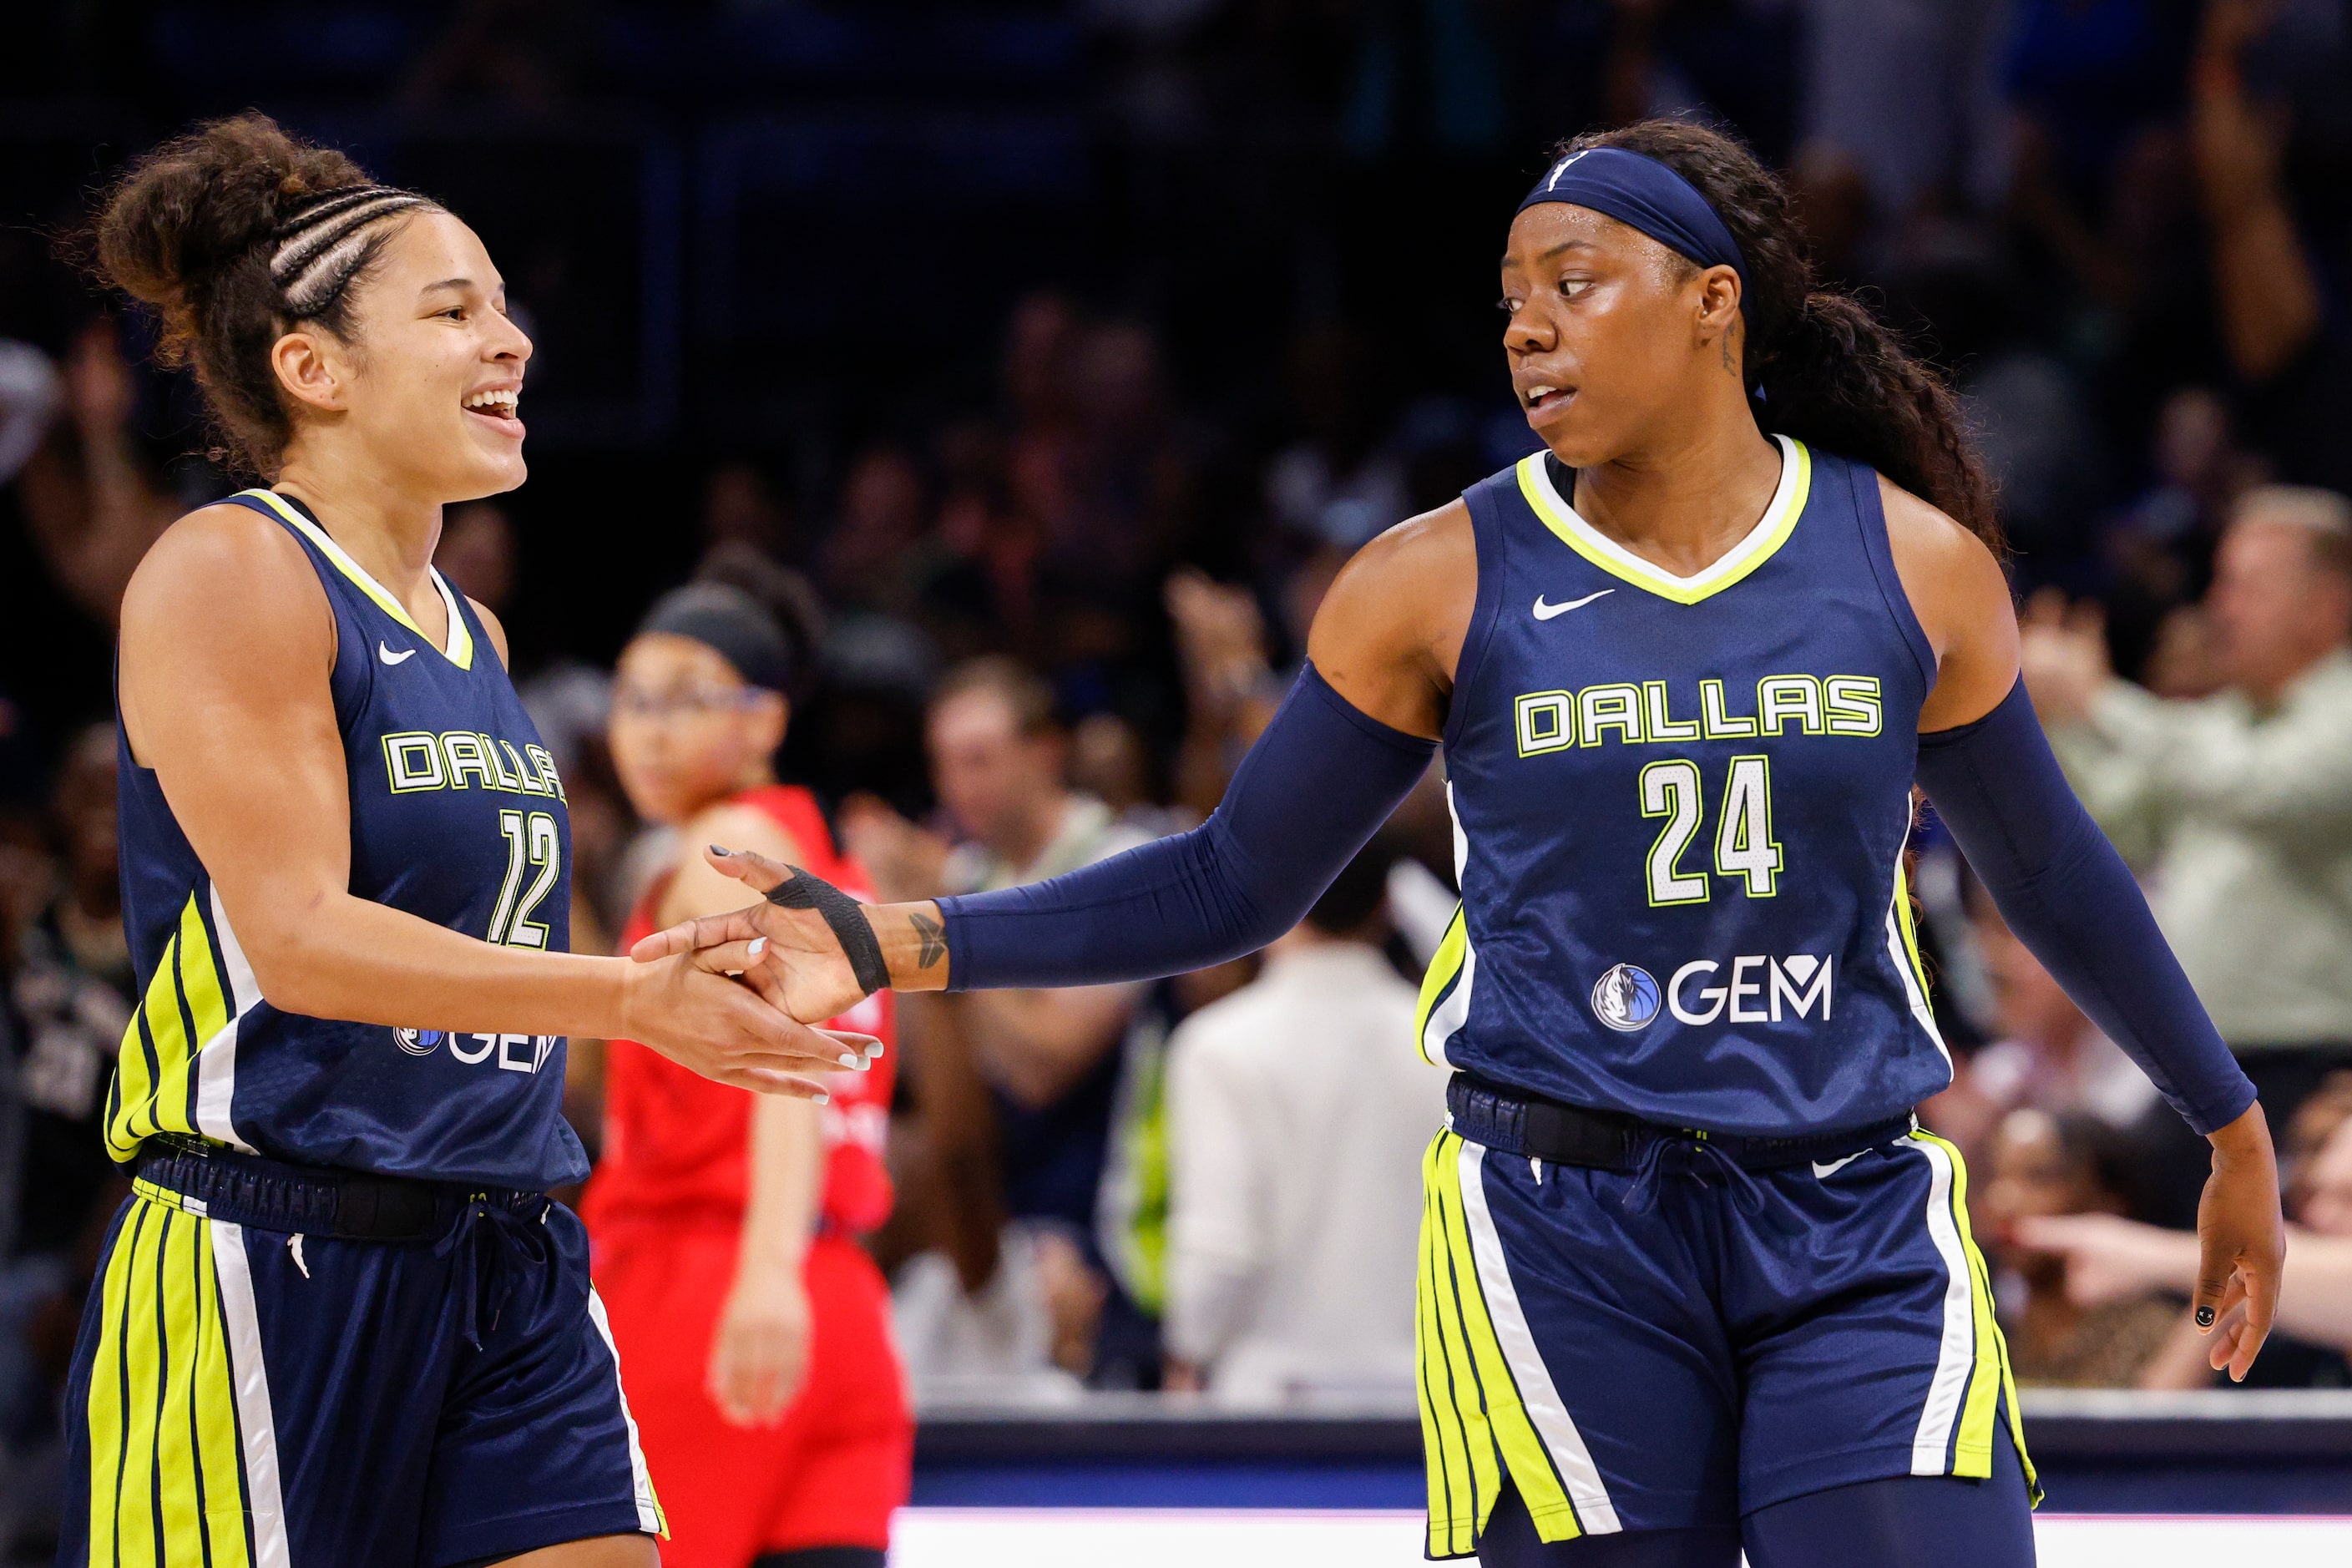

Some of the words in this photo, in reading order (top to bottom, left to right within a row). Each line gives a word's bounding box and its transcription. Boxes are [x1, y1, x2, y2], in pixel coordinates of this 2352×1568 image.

[1515, 674, 1883, 757] DALLAS
[381, 730, 569, 809] DALLA
[1639, 755, 1783, 907] 24
[487, 809, 560, 951] 12
[1667, 954, 1832, 1025] GEM
